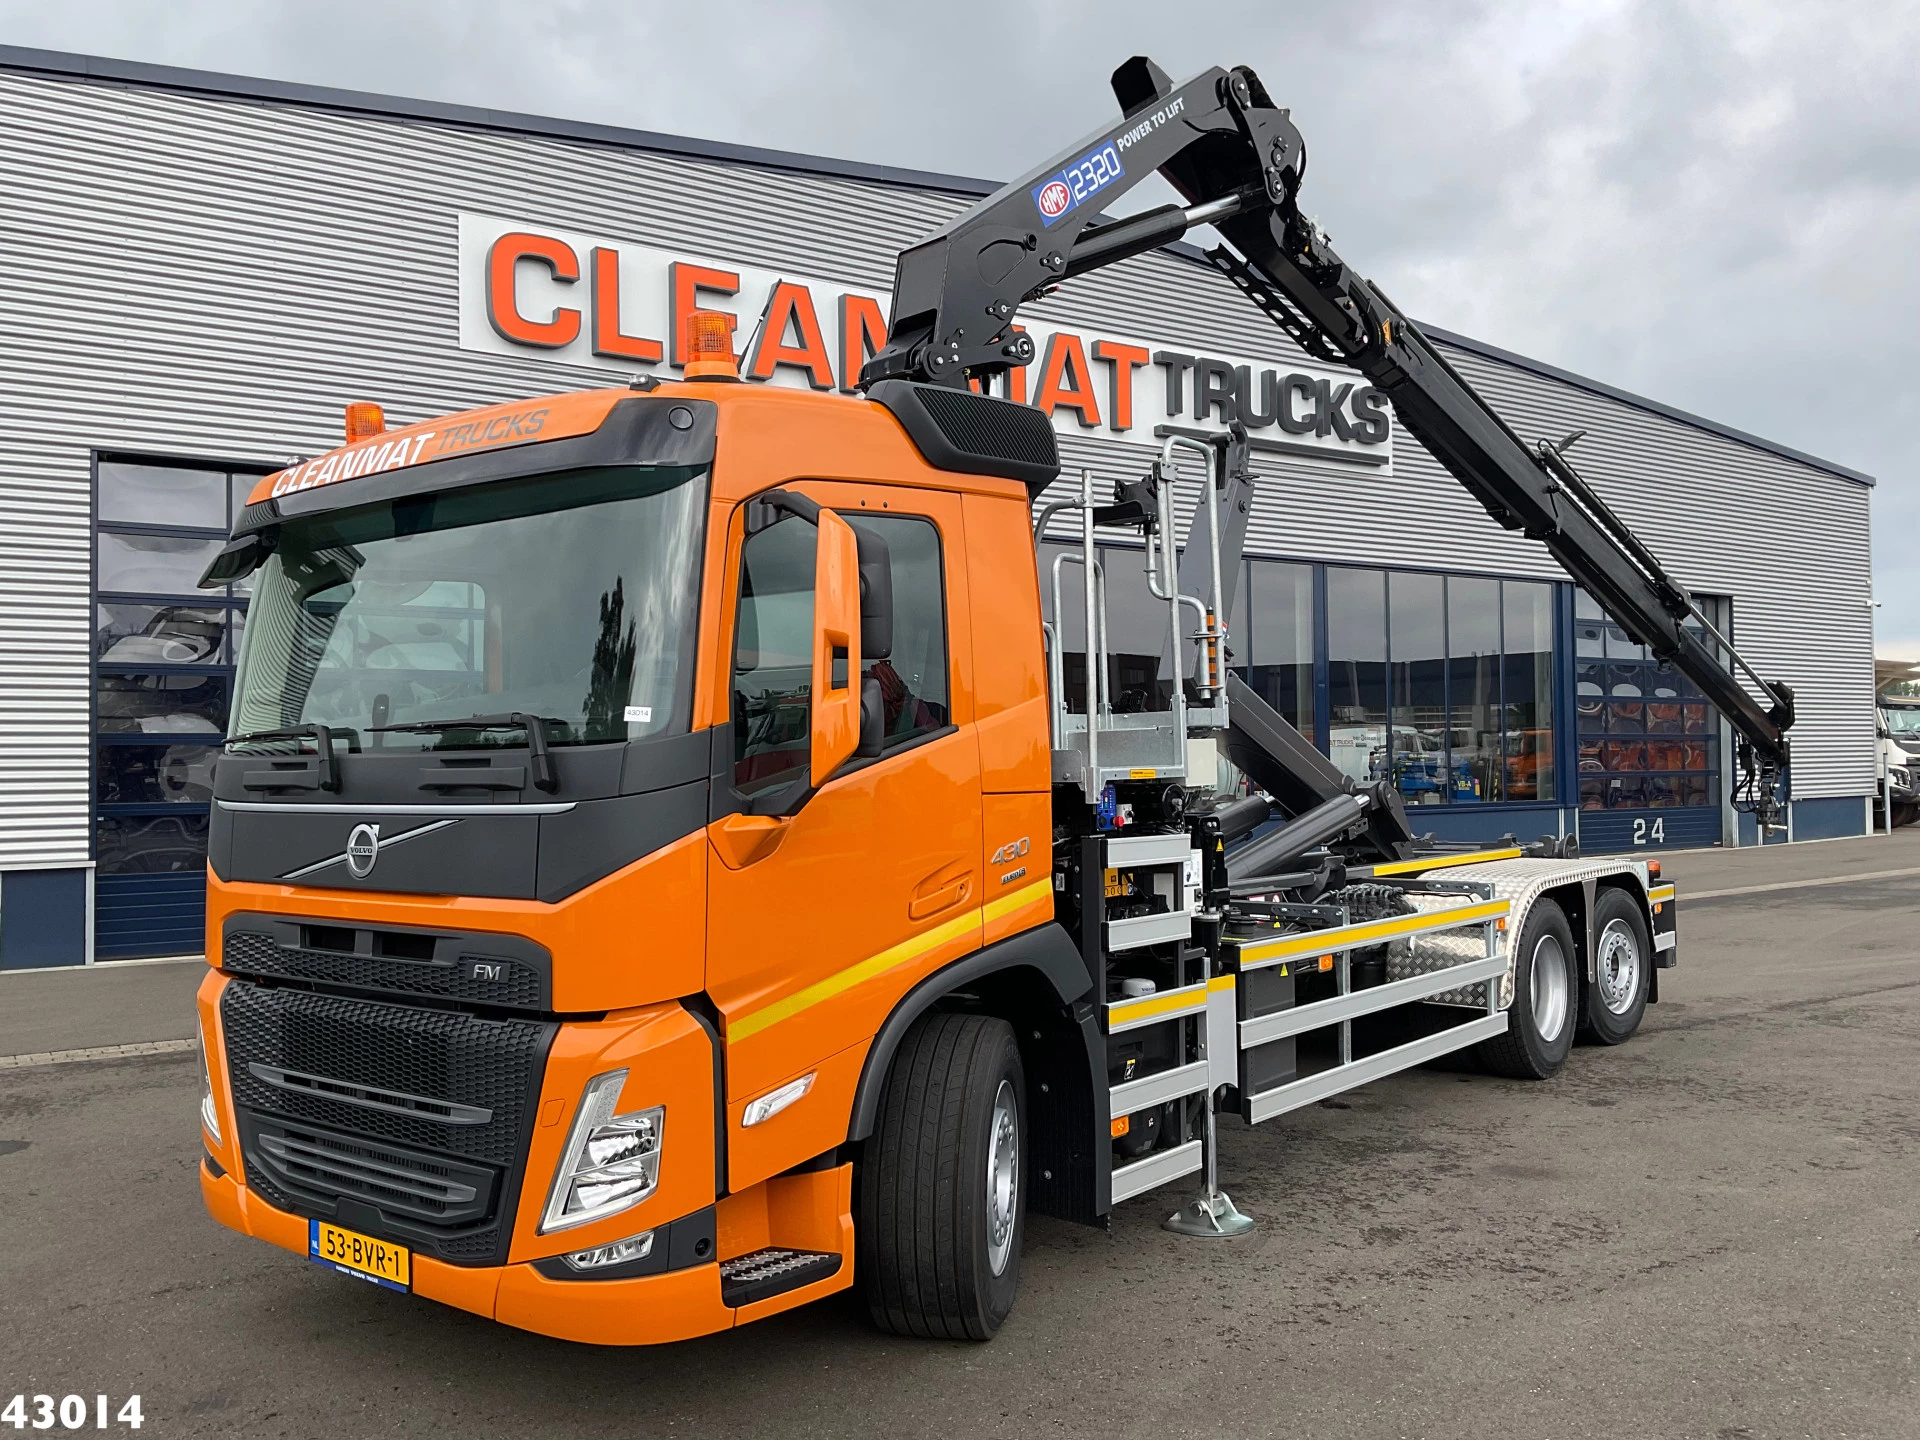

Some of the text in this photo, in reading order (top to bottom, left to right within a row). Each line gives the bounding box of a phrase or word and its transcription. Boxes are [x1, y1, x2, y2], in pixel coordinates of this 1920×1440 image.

[1117, 97, 1185, 152] POWER TO LIFT
[1042, 147, 1121, 213] HMF 2320
[1153, 350, 1390, 445] TRUCKS
[271, 409, 549, 498] CLEANMAT TRUCKS
[991, 836, 1030, 865] 430
[1633, 817, 1665, 845] 24
[473, 964, 502, 980] FM
[312, 1240, 319, 1249] NL
[326, 1229, 399, 1277] 53-BVR-1
